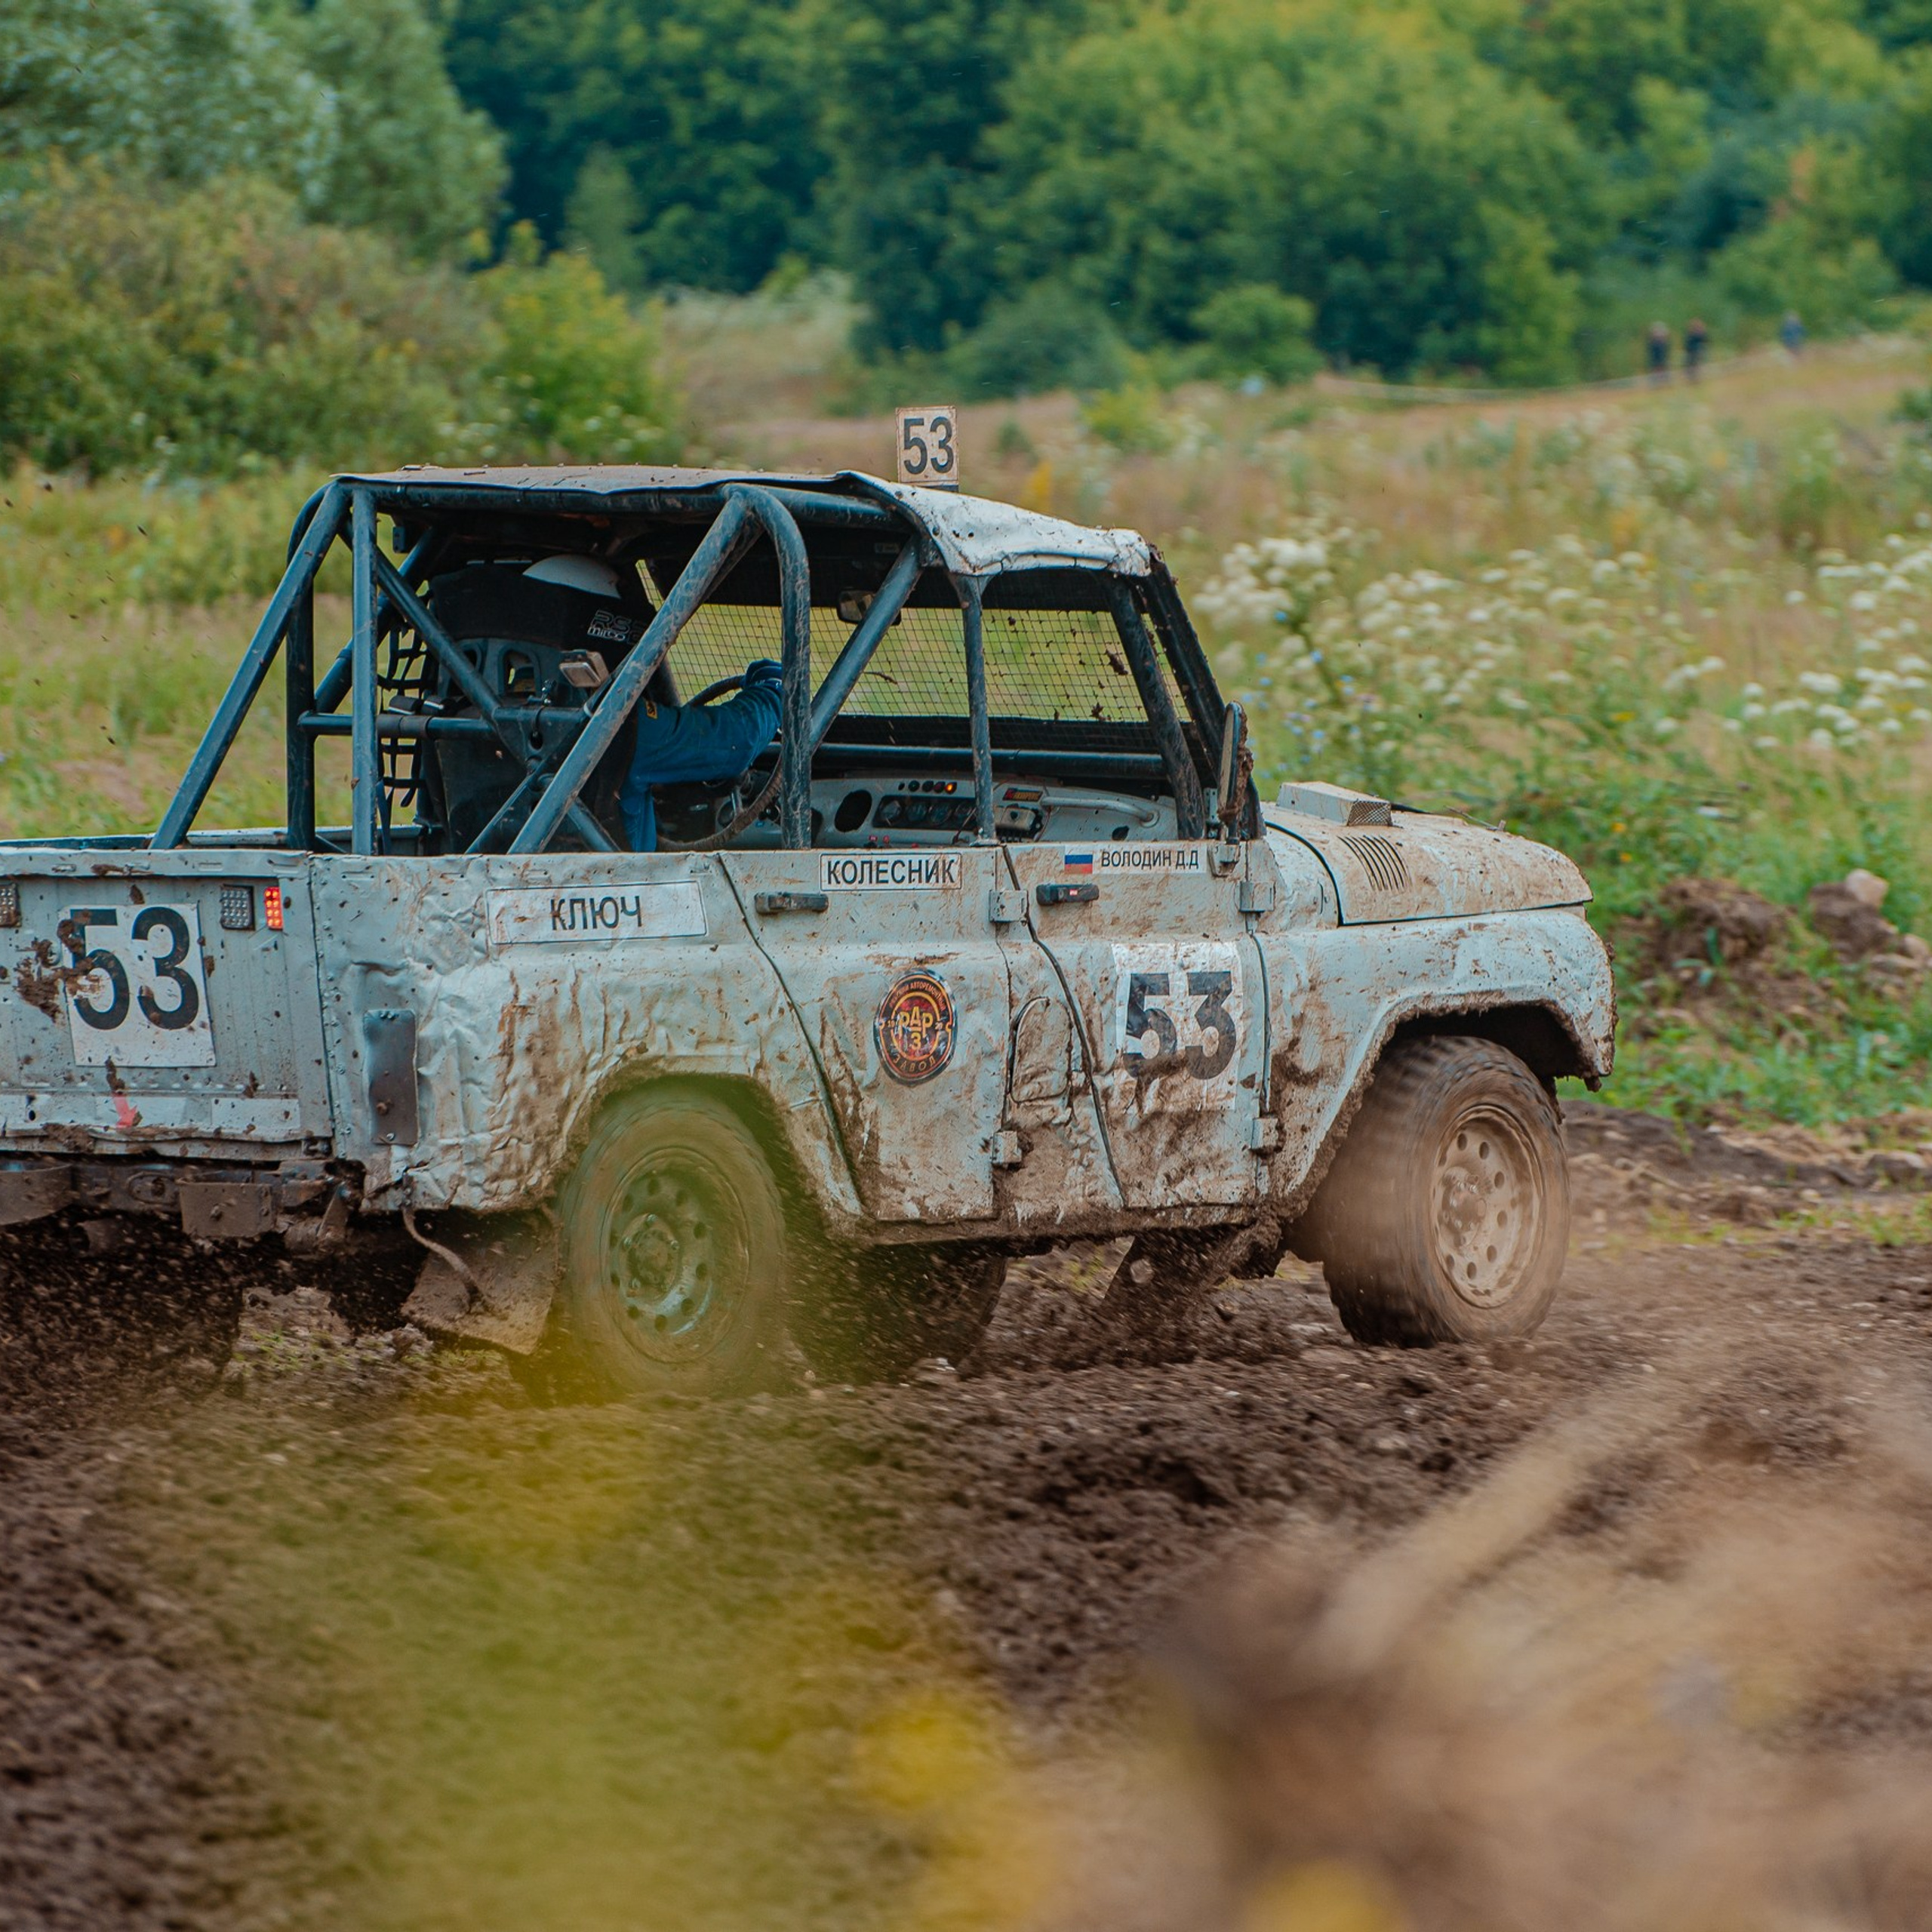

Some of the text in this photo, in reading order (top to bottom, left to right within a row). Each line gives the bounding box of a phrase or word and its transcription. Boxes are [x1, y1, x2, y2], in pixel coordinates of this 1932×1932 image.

[903, 416, 954, 475] 53
[827, 859, 955, 884] КОЛЕСНИК
[1101, 851, 1171, 869] ВОЛОДИН
[550, 895, 642, 931] КЛЮЧ
[69, 906, 199, 1030] 53
[1122, 971, 1237, 1080] 53
[893, 1055, 937, 1072] ЗАВОД
